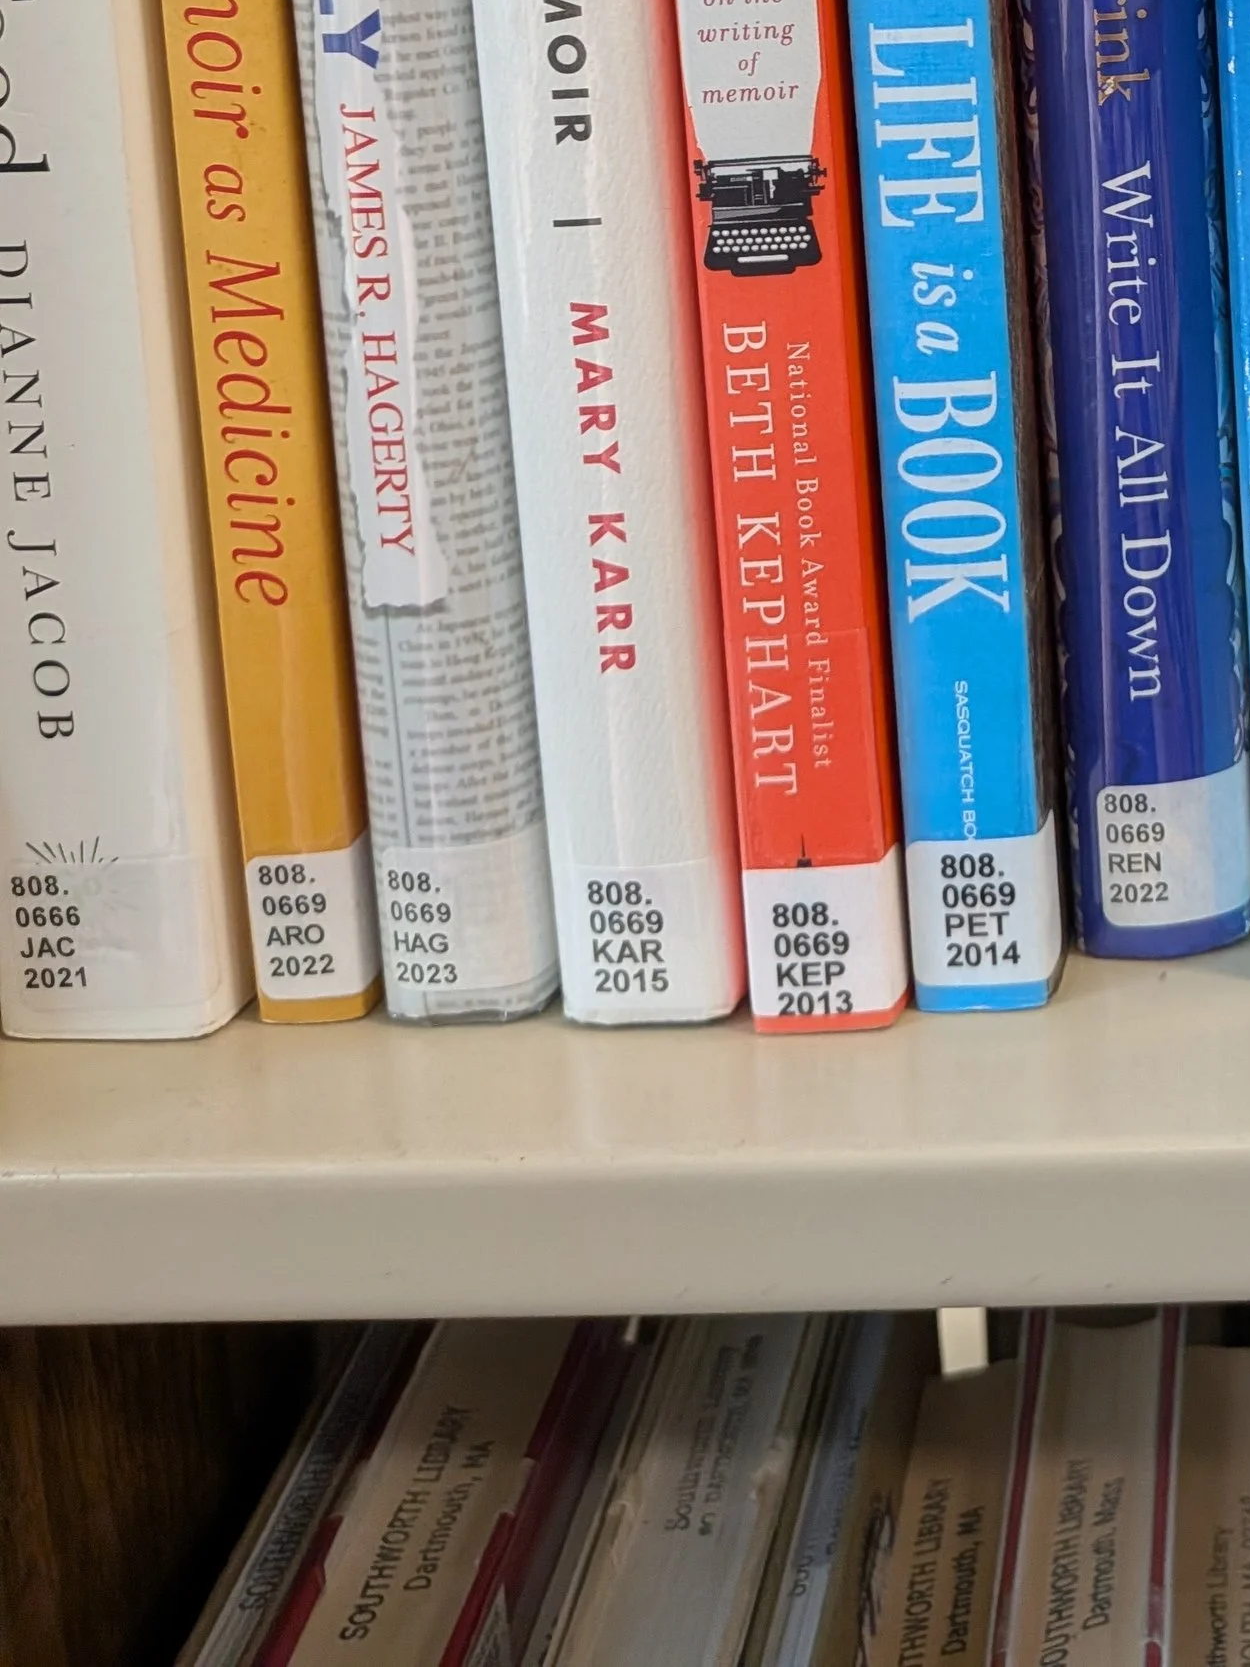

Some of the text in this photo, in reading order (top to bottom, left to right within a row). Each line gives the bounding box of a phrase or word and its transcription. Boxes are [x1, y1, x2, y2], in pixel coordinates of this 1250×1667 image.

[698, 20, 795, 45] writing
[738, 52, 761, 75] of
[702, 84, 799, 104] memoir
[868, 18, 985, 228] LIFE
[202, 162, 247, 223] as
[339, 102, 390, 259] JAMES
[354, 273, 391, 318] R.
[911, 260, 974, 308] is
[915, 322, 960, 355] a
[569, 301, 622, 473] MARY
[205, 248, 297, 607] Medicine
[1100, 160, 1172, 702] Write It All Down
[361, 331, 416, 558] HAGERTY
[0, 239, 75, 740] DIANNE JACOB
[893, 371, 1011, 624] BOOK
[722, 320, 797, 795] BETH KEPHART
[786, 341, 832, 769] National Book Award Finalist
[588, 512, 637, 674] KARR
[955, 680, 975, 803] SASQUATCH
[1104, 793, 1156, 814] 808.
[1106, 822, 1165, 844] 0669
[258, 864, 316, 886] 808.
[940, 854, 1005, 878] 808.
[1108, 852, 1162, 874] REN
[11, 875, 69, 897] 808.
[387, 870, 441, 893] 808.
[587, 881, 652, 905] 808.
[1109, 882, 1169, 903] 2022
[262, 893, 327, 916] 0669
[942, 883, 1016, 907] 0669
[15, 905, 81, 927] 0666
[390, 901, 451, 924] 0669
[589, 910, 664, 934] 0669
[772, 903, 838, 928] 808.
[944, 912, 1009, 937] PET
[20, 936, 75, 959] JAC
[267, 924, 325, 947] ARO
[393, 931, 449, 955] HAG
[774, 933, 850, 957] 0669
[593, 939, 663, 964] KAR
[946, 942, 1020, 967] 2014
[270, 954, 334, 977] 2022
[396, 961, 457, 984] 2023
[777, 962, 846, 988] KEP
[24, 967, 88, 990] 2021
[595, 968, 669, 993] 2015
[778, 991, 853, 1016] 2013
[338, 1489, 430, 1642] SOUTHWORTH
